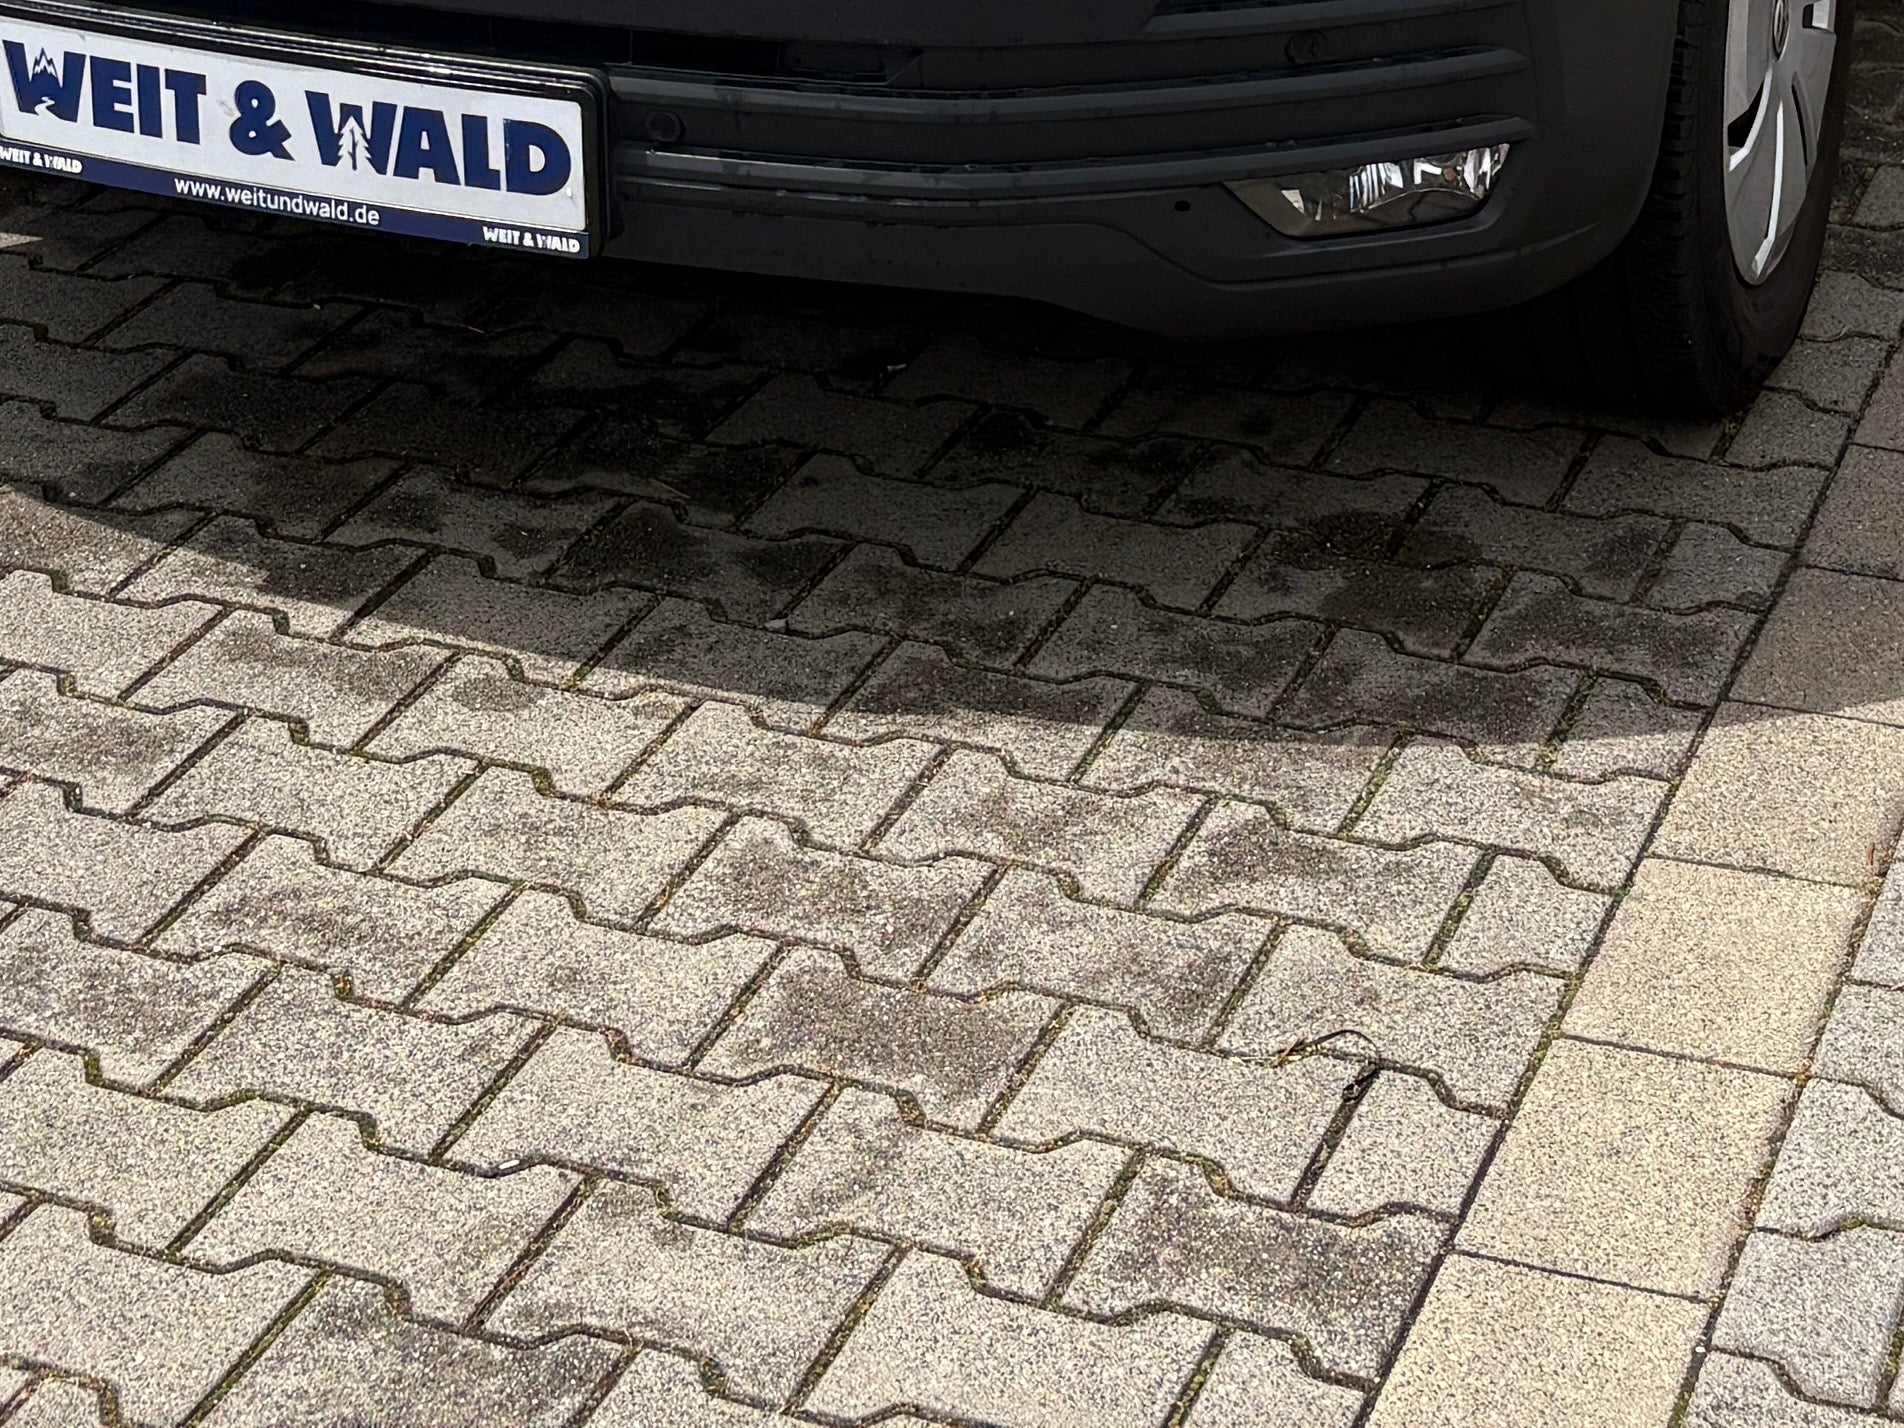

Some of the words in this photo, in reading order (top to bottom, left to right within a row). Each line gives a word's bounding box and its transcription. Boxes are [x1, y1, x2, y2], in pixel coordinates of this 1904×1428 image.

[2, 39, 207, 145] WEIT
[229, 79, 295, 162] &
[304, 89, 572, 196] WALD
[32, 152, 44, 167] &
[174, 178, 381, 226] www.weitundwald.de
[482, 225, 521, 246] WEIT
[522, 232, 535, 248] &
